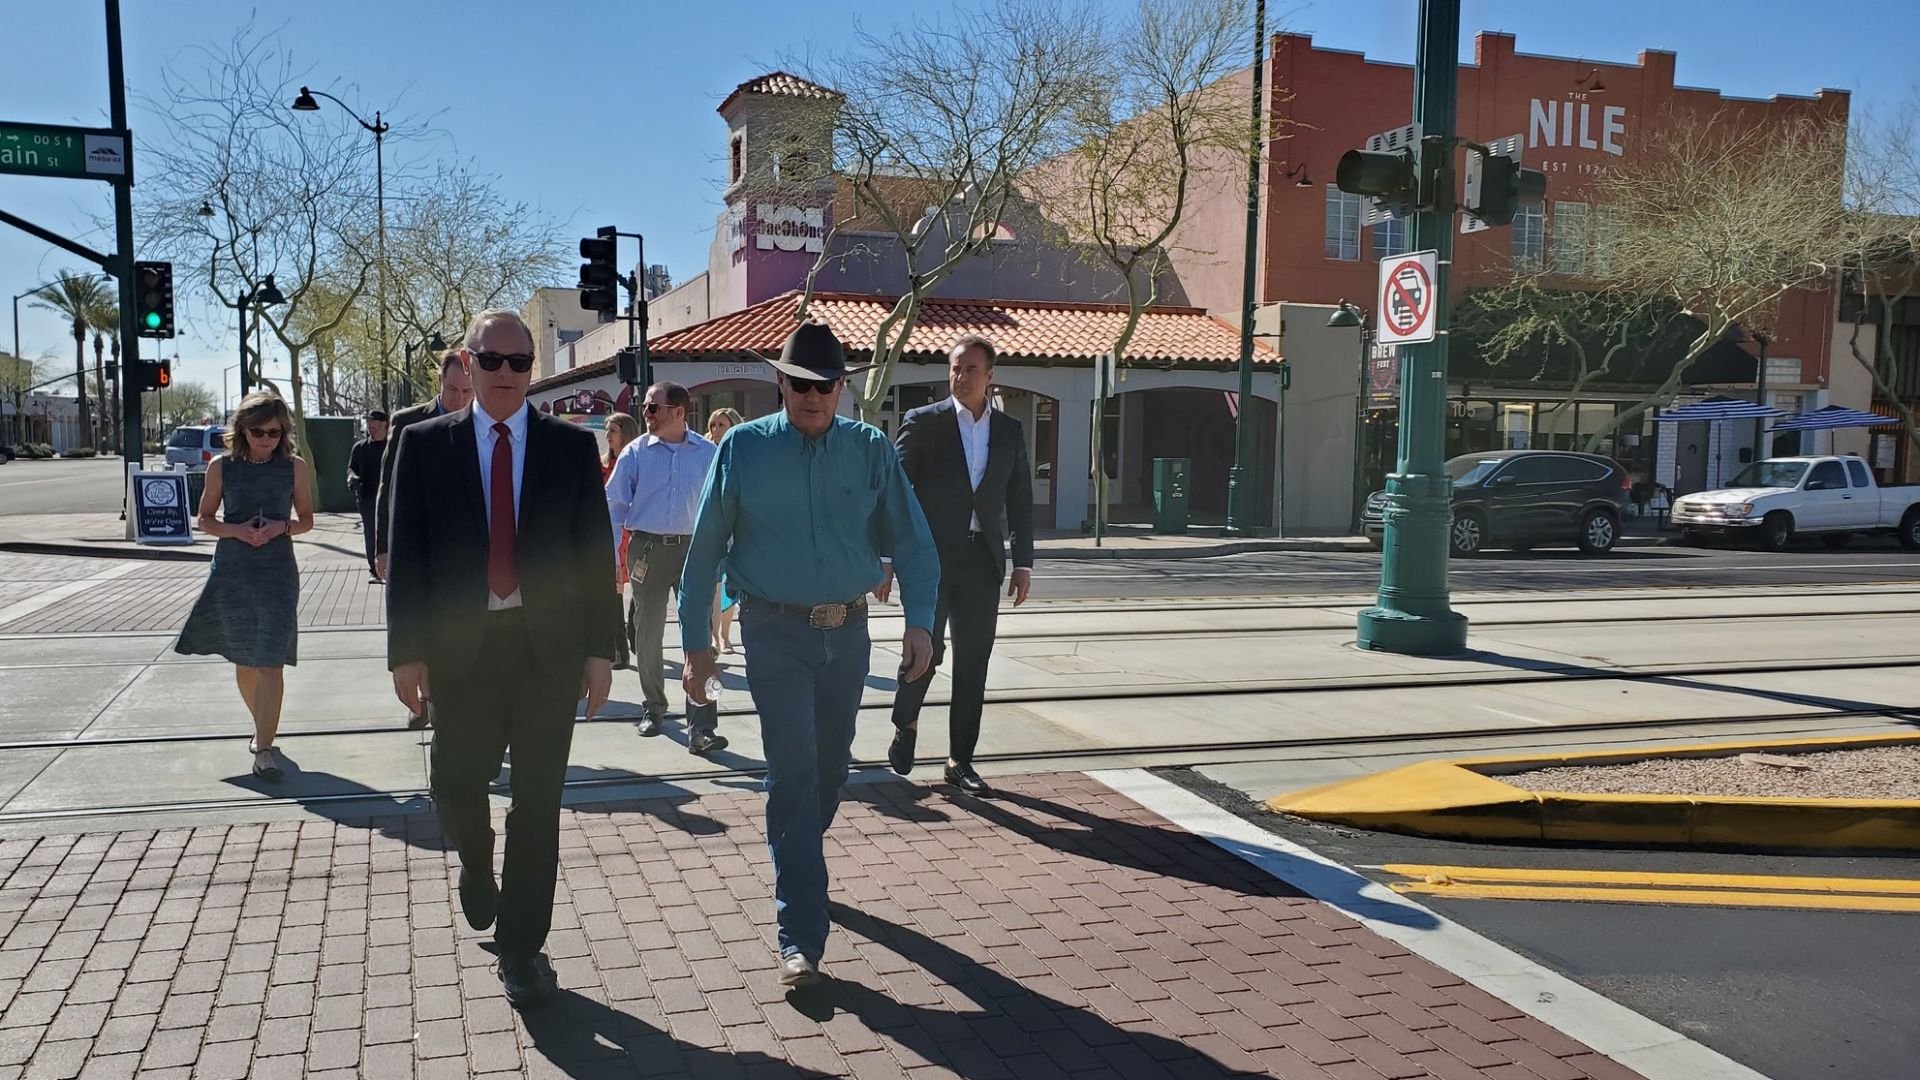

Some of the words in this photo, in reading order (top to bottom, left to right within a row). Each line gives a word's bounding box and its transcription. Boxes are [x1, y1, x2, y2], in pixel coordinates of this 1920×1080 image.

[1568, 92, 1588, 101] THE
[1529, 98, 1626, 157] NILE
[54, 136, 61, 146] S
[47, 157, 58, 167] St
[1542, 161, 1568, 172] EST
[1578, 164, 1607, 175] 1924
[1371, 344, 1396, 359] BREW
[1376, 360, 1390, 369] FEST
[1452, 403, 1476, 418] 105
